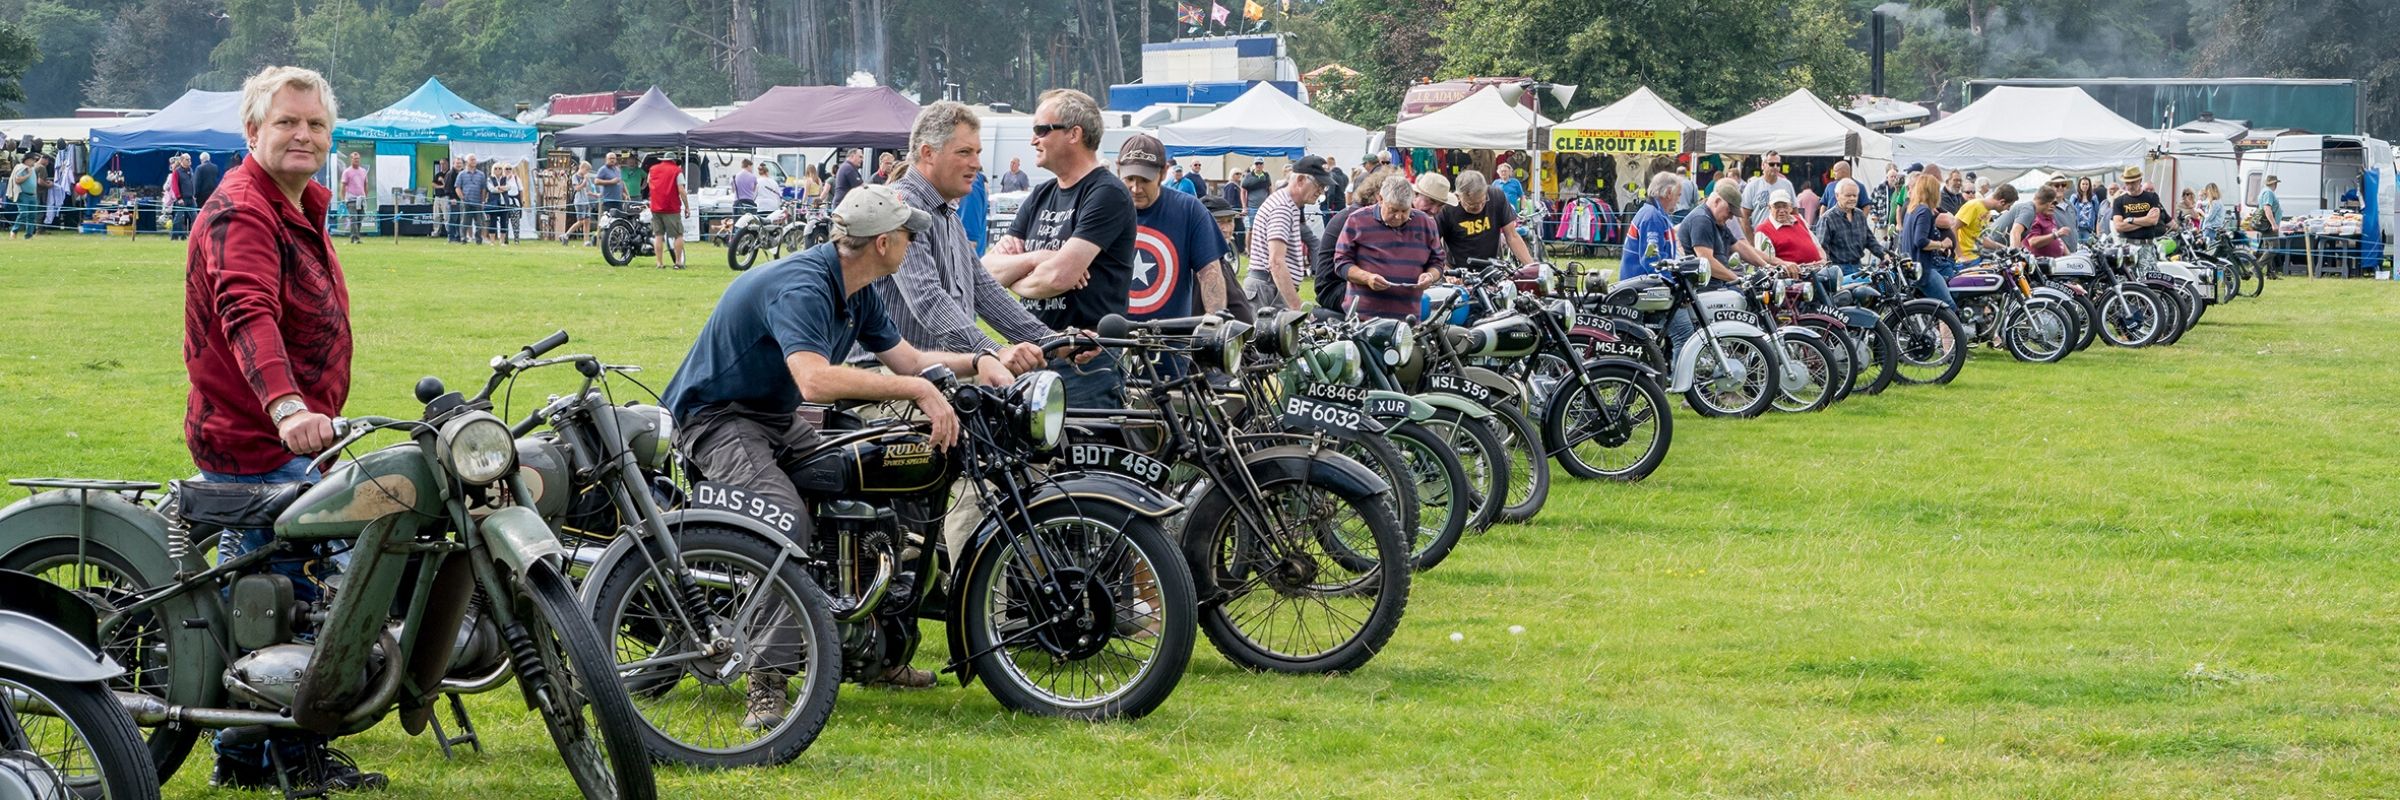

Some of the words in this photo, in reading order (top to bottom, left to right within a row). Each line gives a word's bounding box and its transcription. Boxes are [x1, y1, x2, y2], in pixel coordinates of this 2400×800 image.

[1434, 91, 1465, 101] ADAMS
[1623, 130, 1655, 138] WORLD
[1556, 137, 1636, 151] CLEAROUT
[1640, 139, 1676, 152] SALE
[1460, 216, 1490, 235] BSA
[1616, 305, 1639, 319] 7018
[1431, 376, 1459, 390] WSL
[1463, 380, 1490, 400] 359
[1377, 400, 1406, 413] XUR
[883, 441, 933, 459] RUDGE
[905, 457, 929, 465] SPECIAL
[1072, 446, 1115, 466] BDT
[1120, 453, 1162, 482] 469
[748, 497, 796, 532] 926
